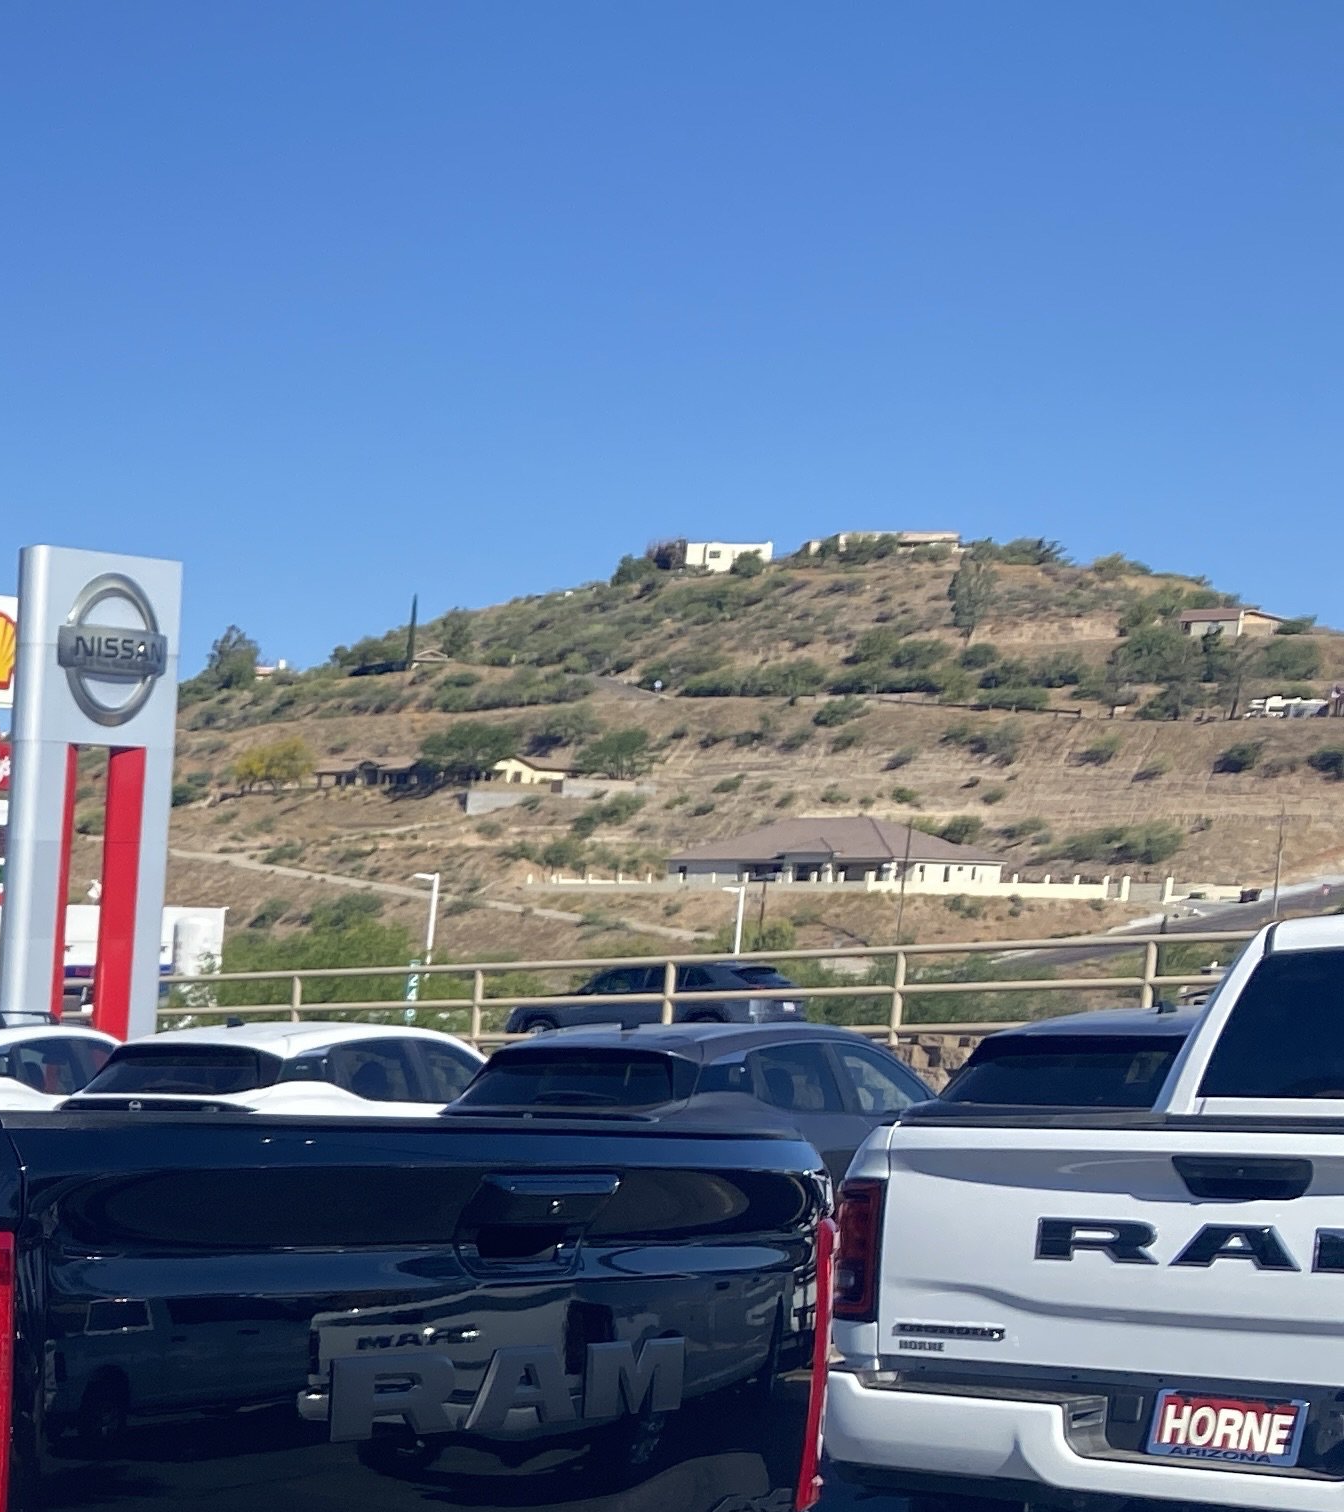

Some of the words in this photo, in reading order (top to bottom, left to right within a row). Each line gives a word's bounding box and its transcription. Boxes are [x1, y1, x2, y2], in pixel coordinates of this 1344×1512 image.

[74, 635, 163, 663] NISSAN
[1034, 1216, 1344, 1274] RA
[899, 1339, 945, 1352] HORNE
[329, 1336, 686, 1443] RAM
[1161, 1403, 1296, 1456] HORNE
[1168, 1446, 1271, 1464] ARIZONA
